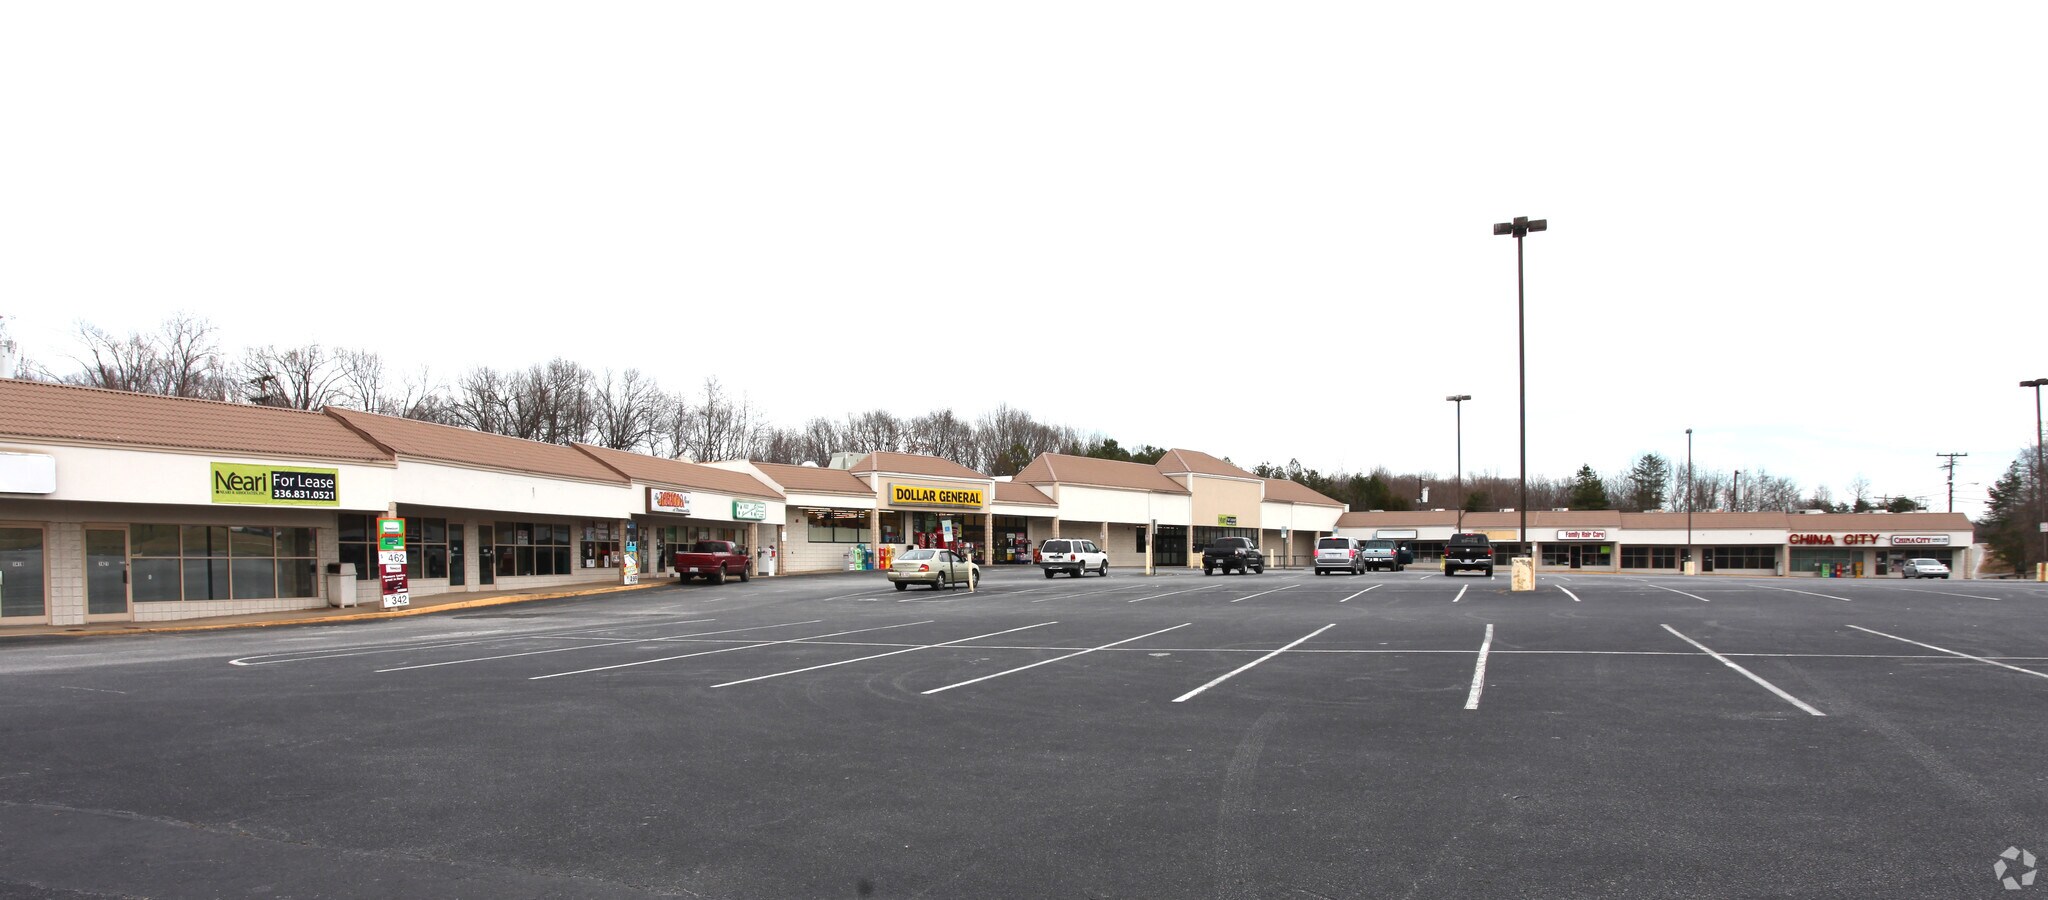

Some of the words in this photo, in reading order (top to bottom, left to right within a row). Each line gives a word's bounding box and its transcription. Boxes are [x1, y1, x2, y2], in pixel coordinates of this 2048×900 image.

[215, 470, 267, 493] Neari
[272, 473, 295, 487] For
[298, 474, 334, 489] Lease
[273, 489, 334, 500] 336.831.0521
[896, 488, 936, 502] DOLLAR
[939, 490, 981, 504] GENERAL
[1789, 533, 1835, 545] CHINA
[1843, 533, 1880, 545] CITY
[388, 553, 405, 563] 462
[391, 594, 407, 605] 342
